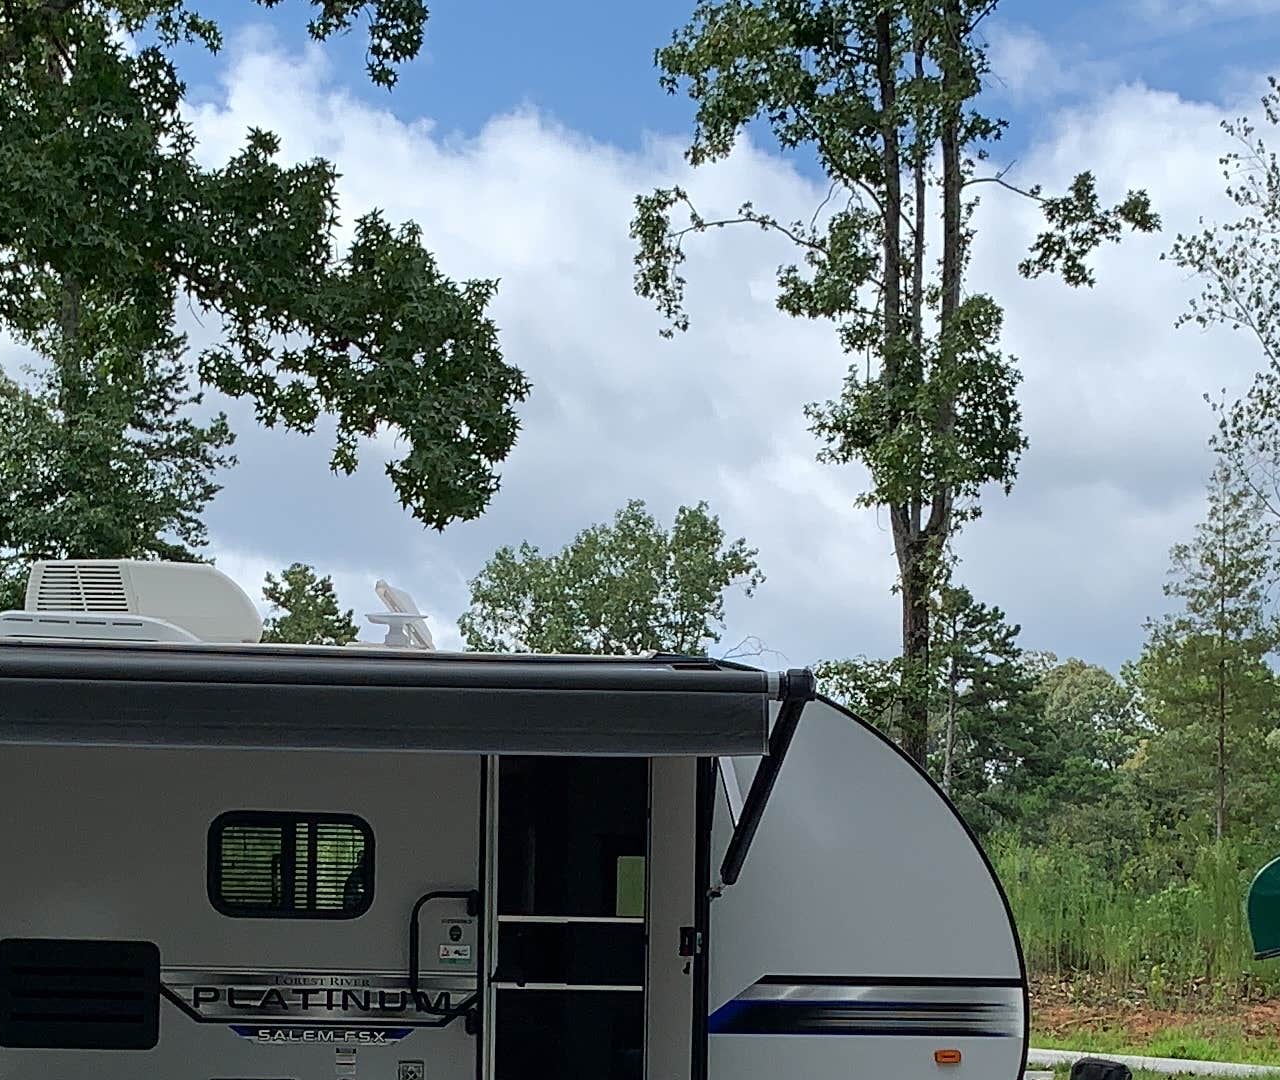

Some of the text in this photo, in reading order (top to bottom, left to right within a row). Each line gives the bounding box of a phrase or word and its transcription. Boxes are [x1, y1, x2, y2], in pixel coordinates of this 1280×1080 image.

[329, 977, 371, 987] RIVER
[193, 986, 452, 1012] PLATINUM
[258, 1029, 386, 1043] SALEM FSX
